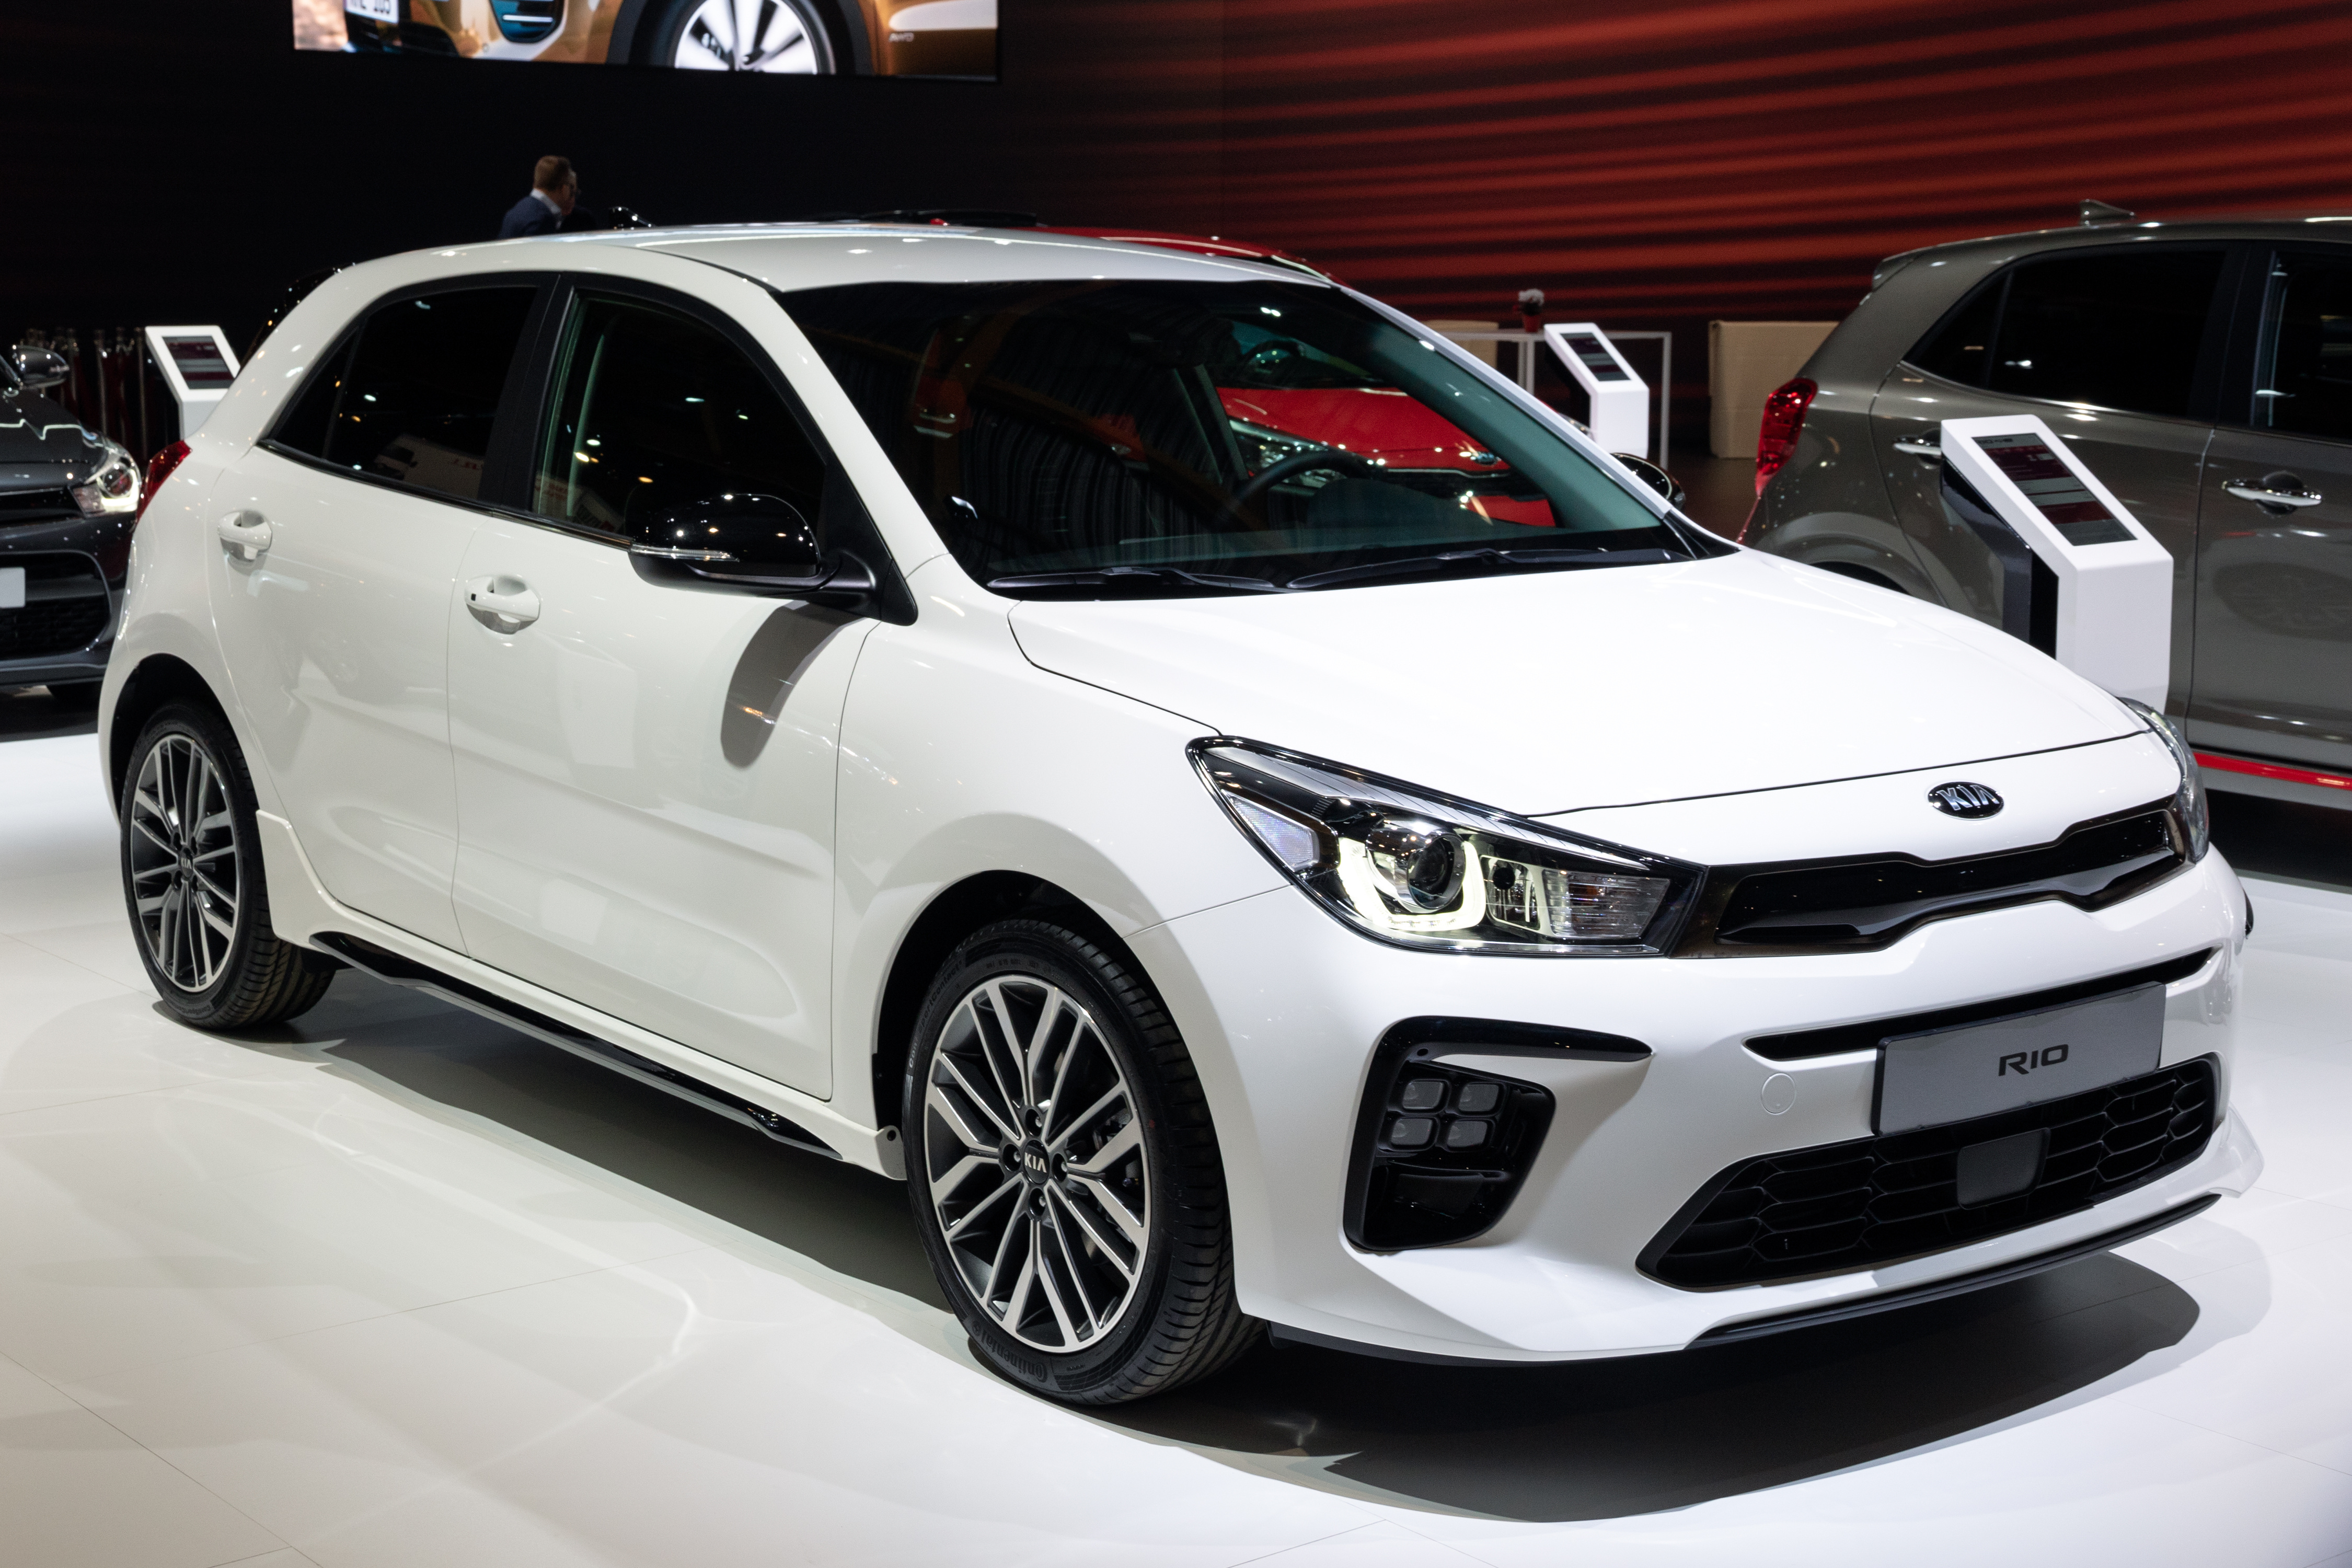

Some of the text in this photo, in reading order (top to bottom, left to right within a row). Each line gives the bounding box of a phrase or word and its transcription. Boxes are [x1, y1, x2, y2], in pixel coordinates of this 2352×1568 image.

[1936, 785, 2000, 811] KIA
[1998, 1044, 2069, 1076] RIO
[1024, 1152, 1047, 1173] KIA
[981, 1330, 1048, 1383] Continental
